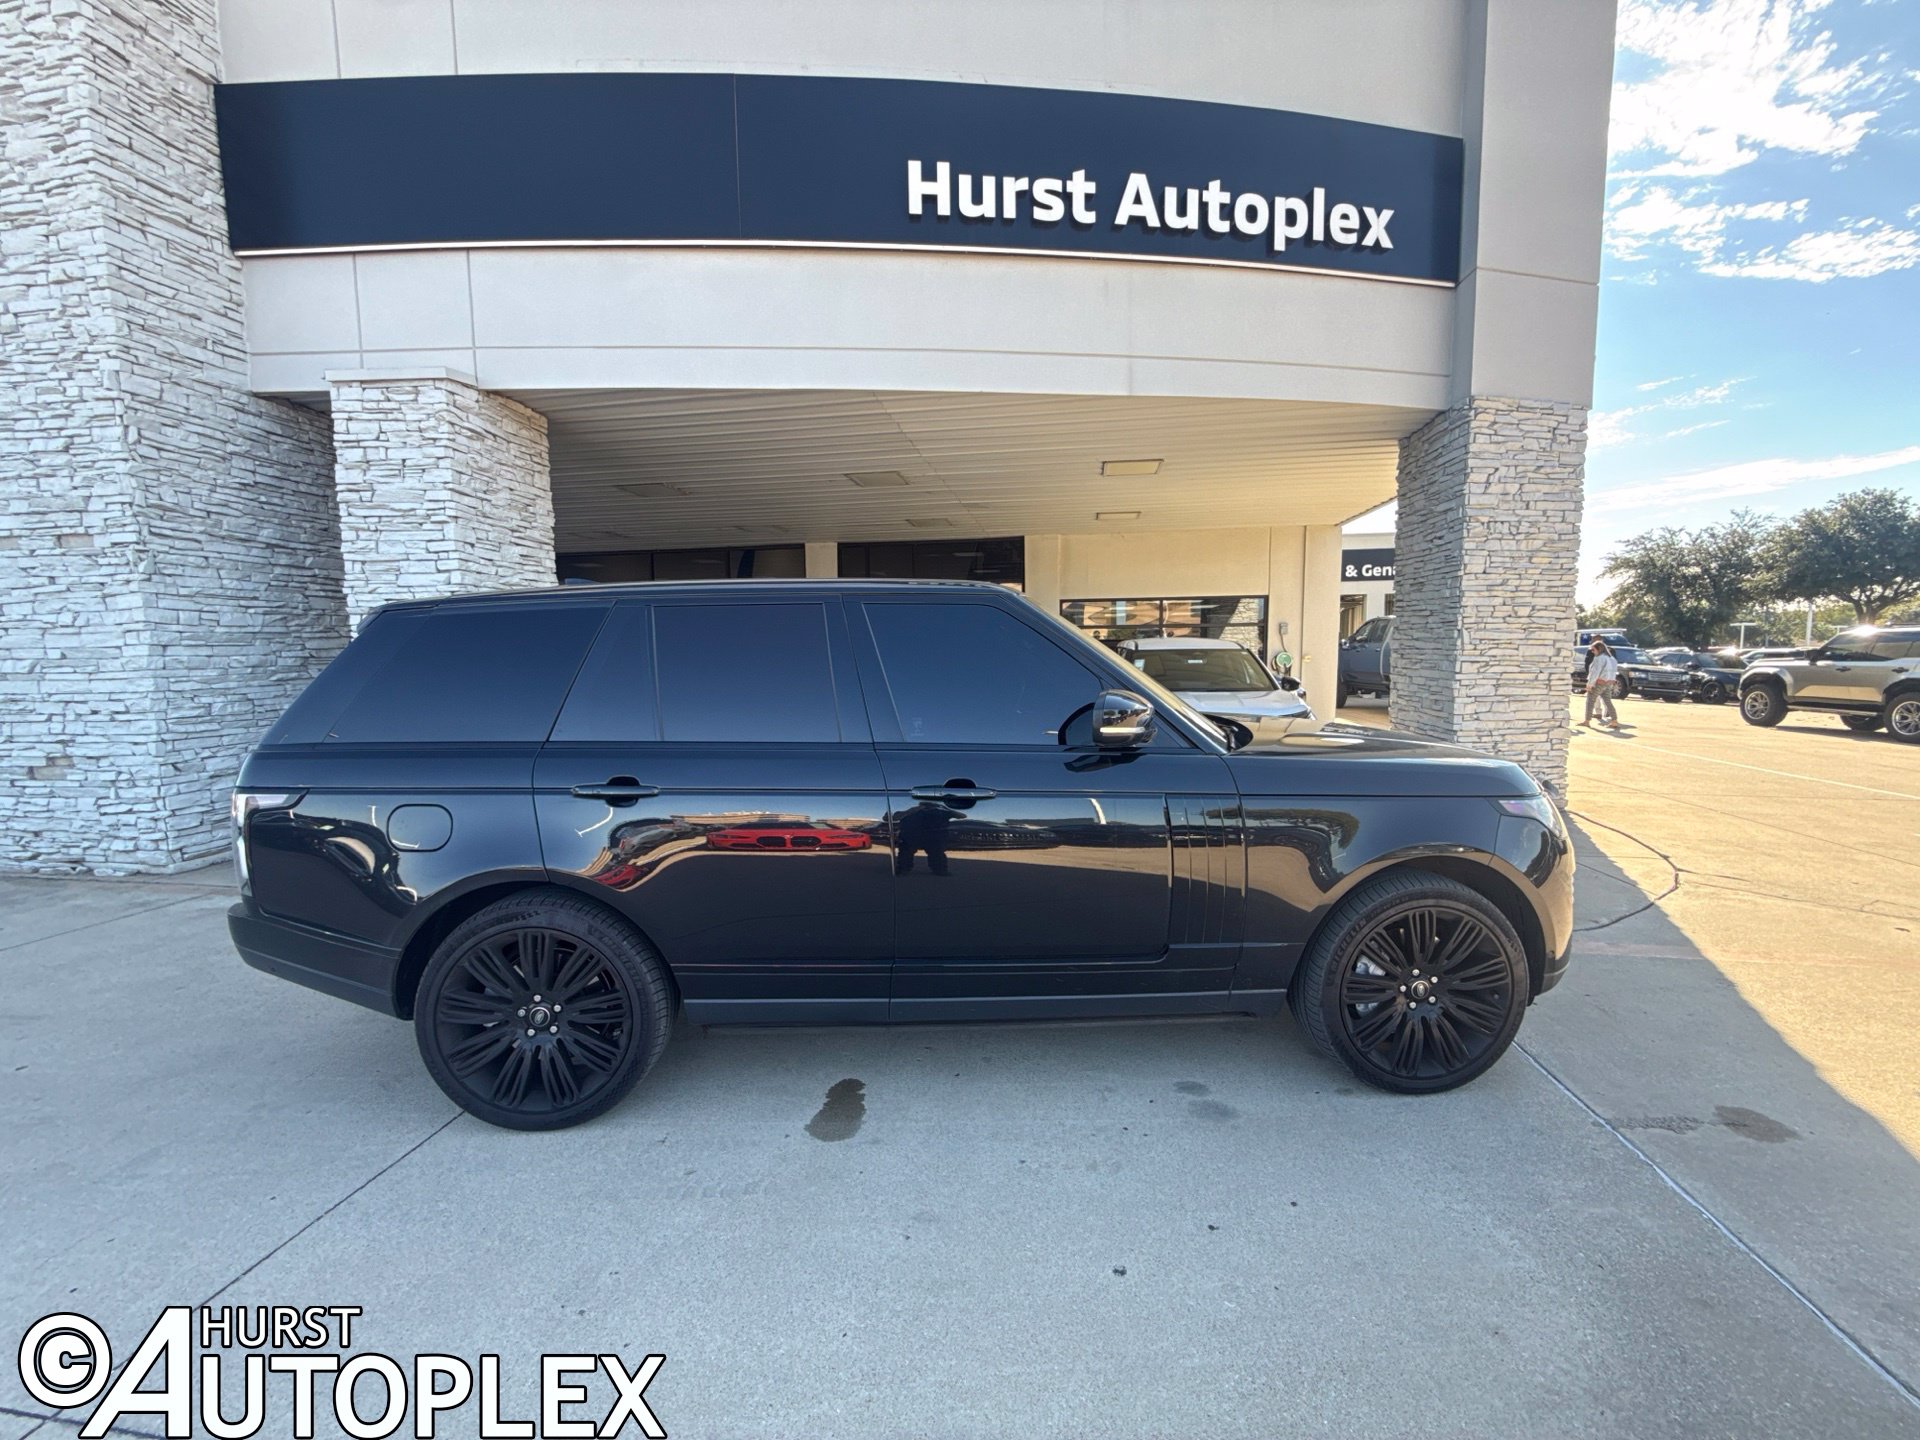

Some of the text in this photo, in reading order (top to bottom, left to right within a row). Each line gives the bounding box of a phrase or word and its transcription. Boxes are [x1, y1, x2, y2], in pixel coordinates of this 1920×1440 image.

[907, 159, 1395, 252] Hurst Autoplex
[1345, 564, 1358, 577] &
